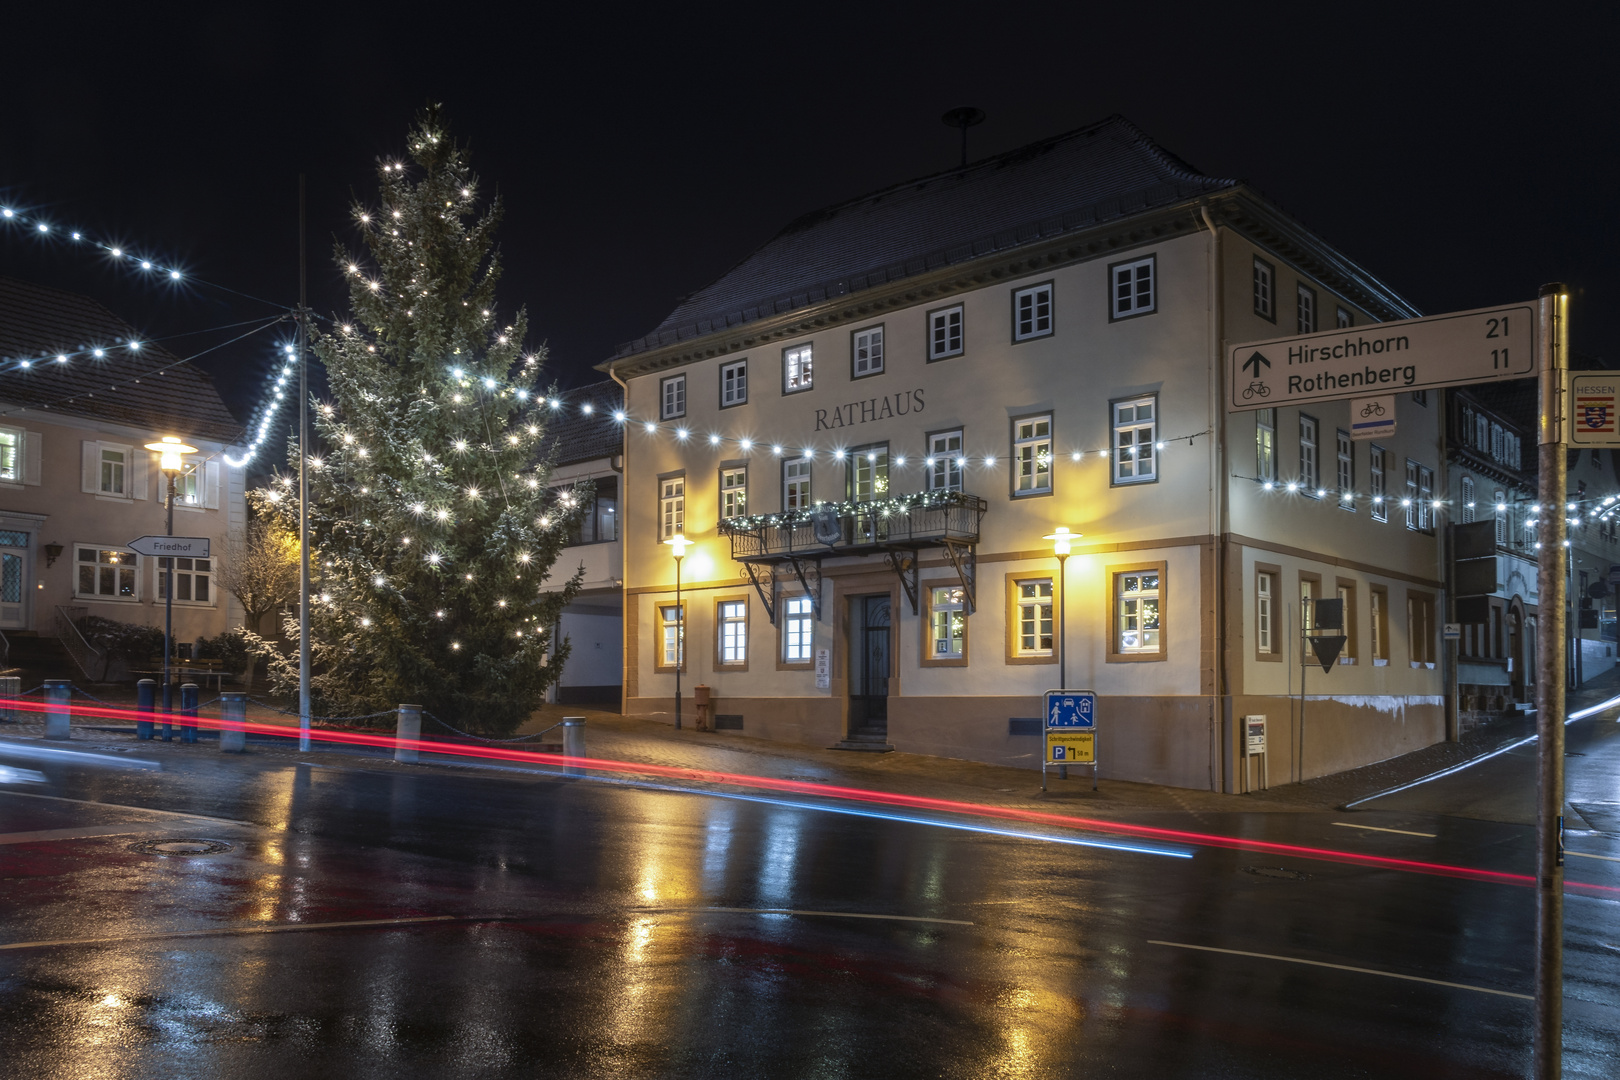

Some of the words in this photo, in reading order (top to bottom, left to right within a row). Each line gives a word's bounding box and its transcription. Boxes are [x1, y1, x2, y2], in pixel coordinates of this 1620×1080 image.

[1288, 335, 1409, 365] Hirschhorn
[1486, 316, 1508, 339] 21
[1288, 365, 1416, 394] Rothenberg
[1491, 348, 1508, 369] 11
[1576, 386, 1615, 394] HESSEN
[814, 388, 925, 432] RATHAUS
[153, 542, 192, 551] Friedhof
[1055, 747, 1063, 758] P
